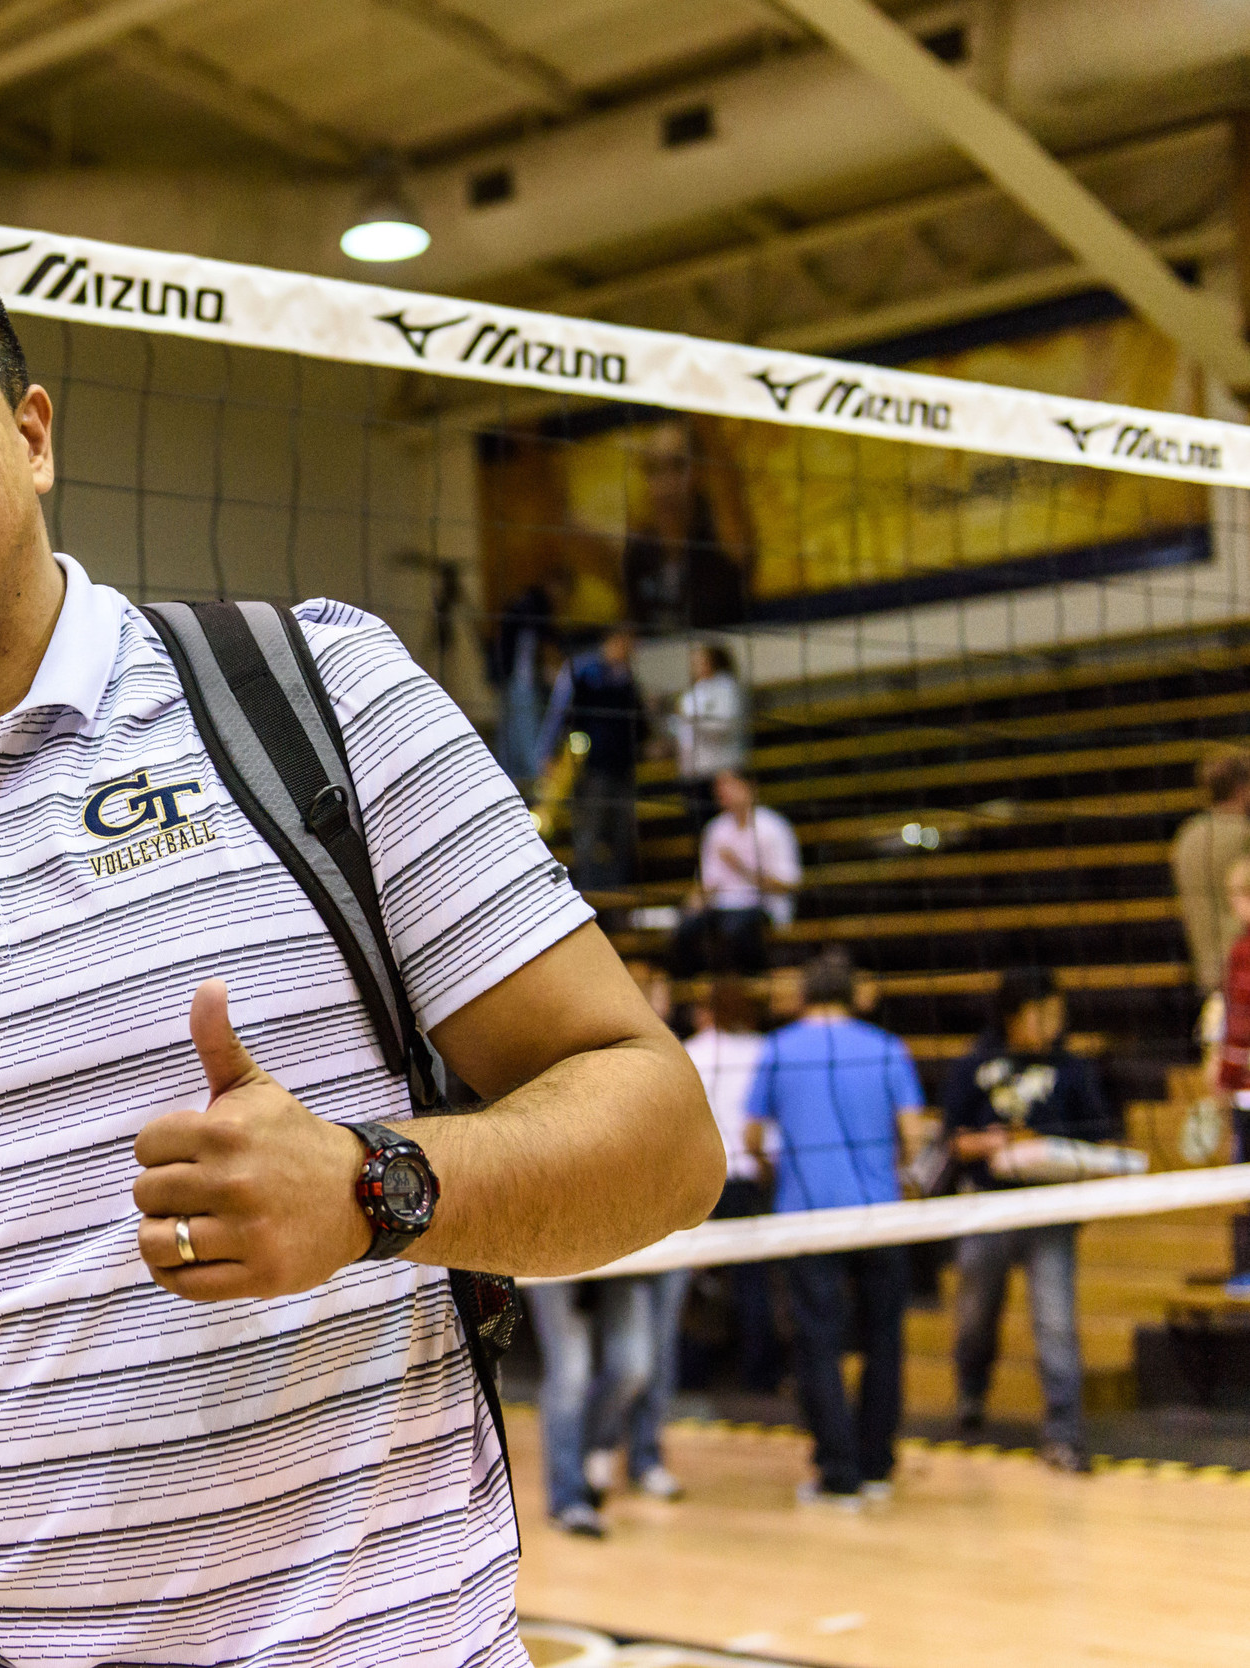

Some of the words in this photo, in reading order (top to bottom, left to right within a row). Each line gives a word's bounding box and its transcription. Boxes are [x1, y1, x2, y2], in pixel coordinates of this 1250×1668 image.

[18, 253, 226, 324] MIZUNO
[459, 322, 627, 385] MIZUNO
[82, 770, 203, 840] GT
[89, 821, 217, 878] VOLLEYBALL
